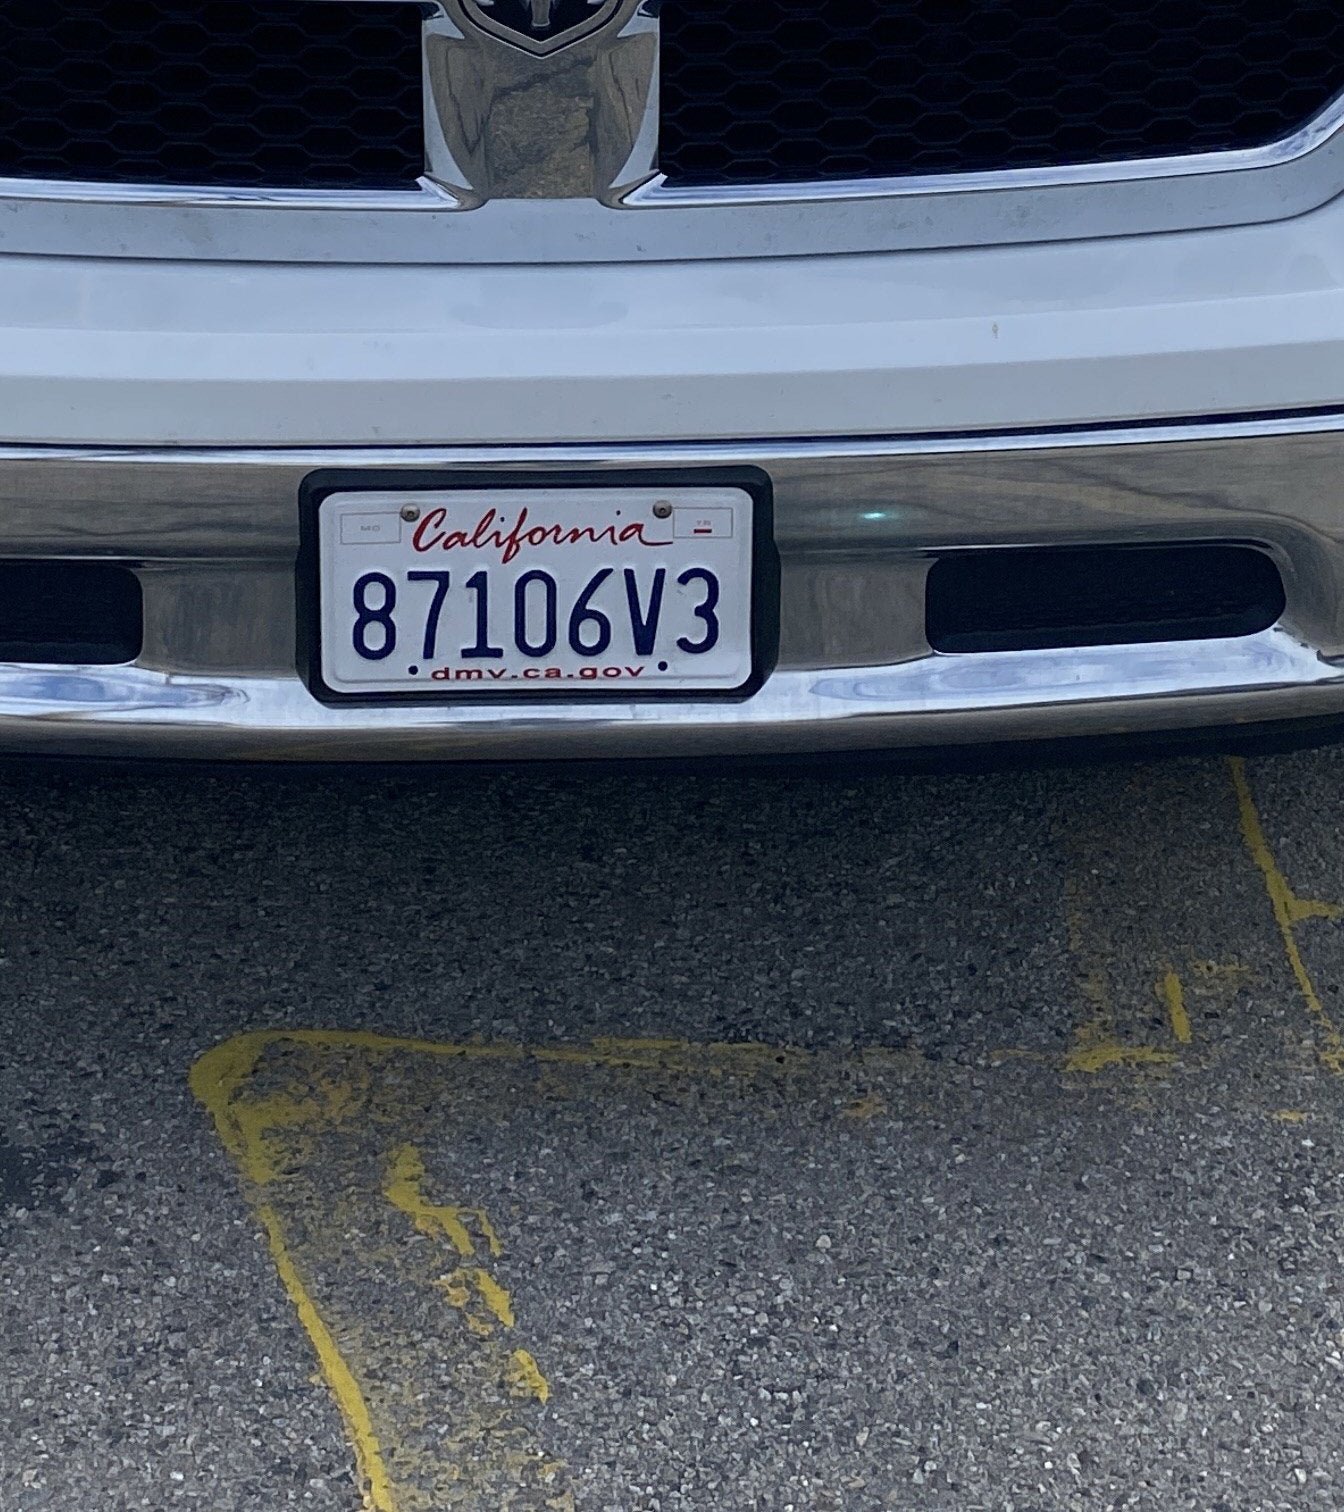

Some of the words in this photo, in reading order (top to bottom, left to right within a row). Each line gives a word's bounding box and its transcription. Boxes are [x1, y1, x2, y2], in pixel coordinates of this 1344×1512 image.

[412, 506, 673, 564] California
[352, 567, 720, 661] 87106V3
[431, 666, 645, 680] dmv.ca.gov
